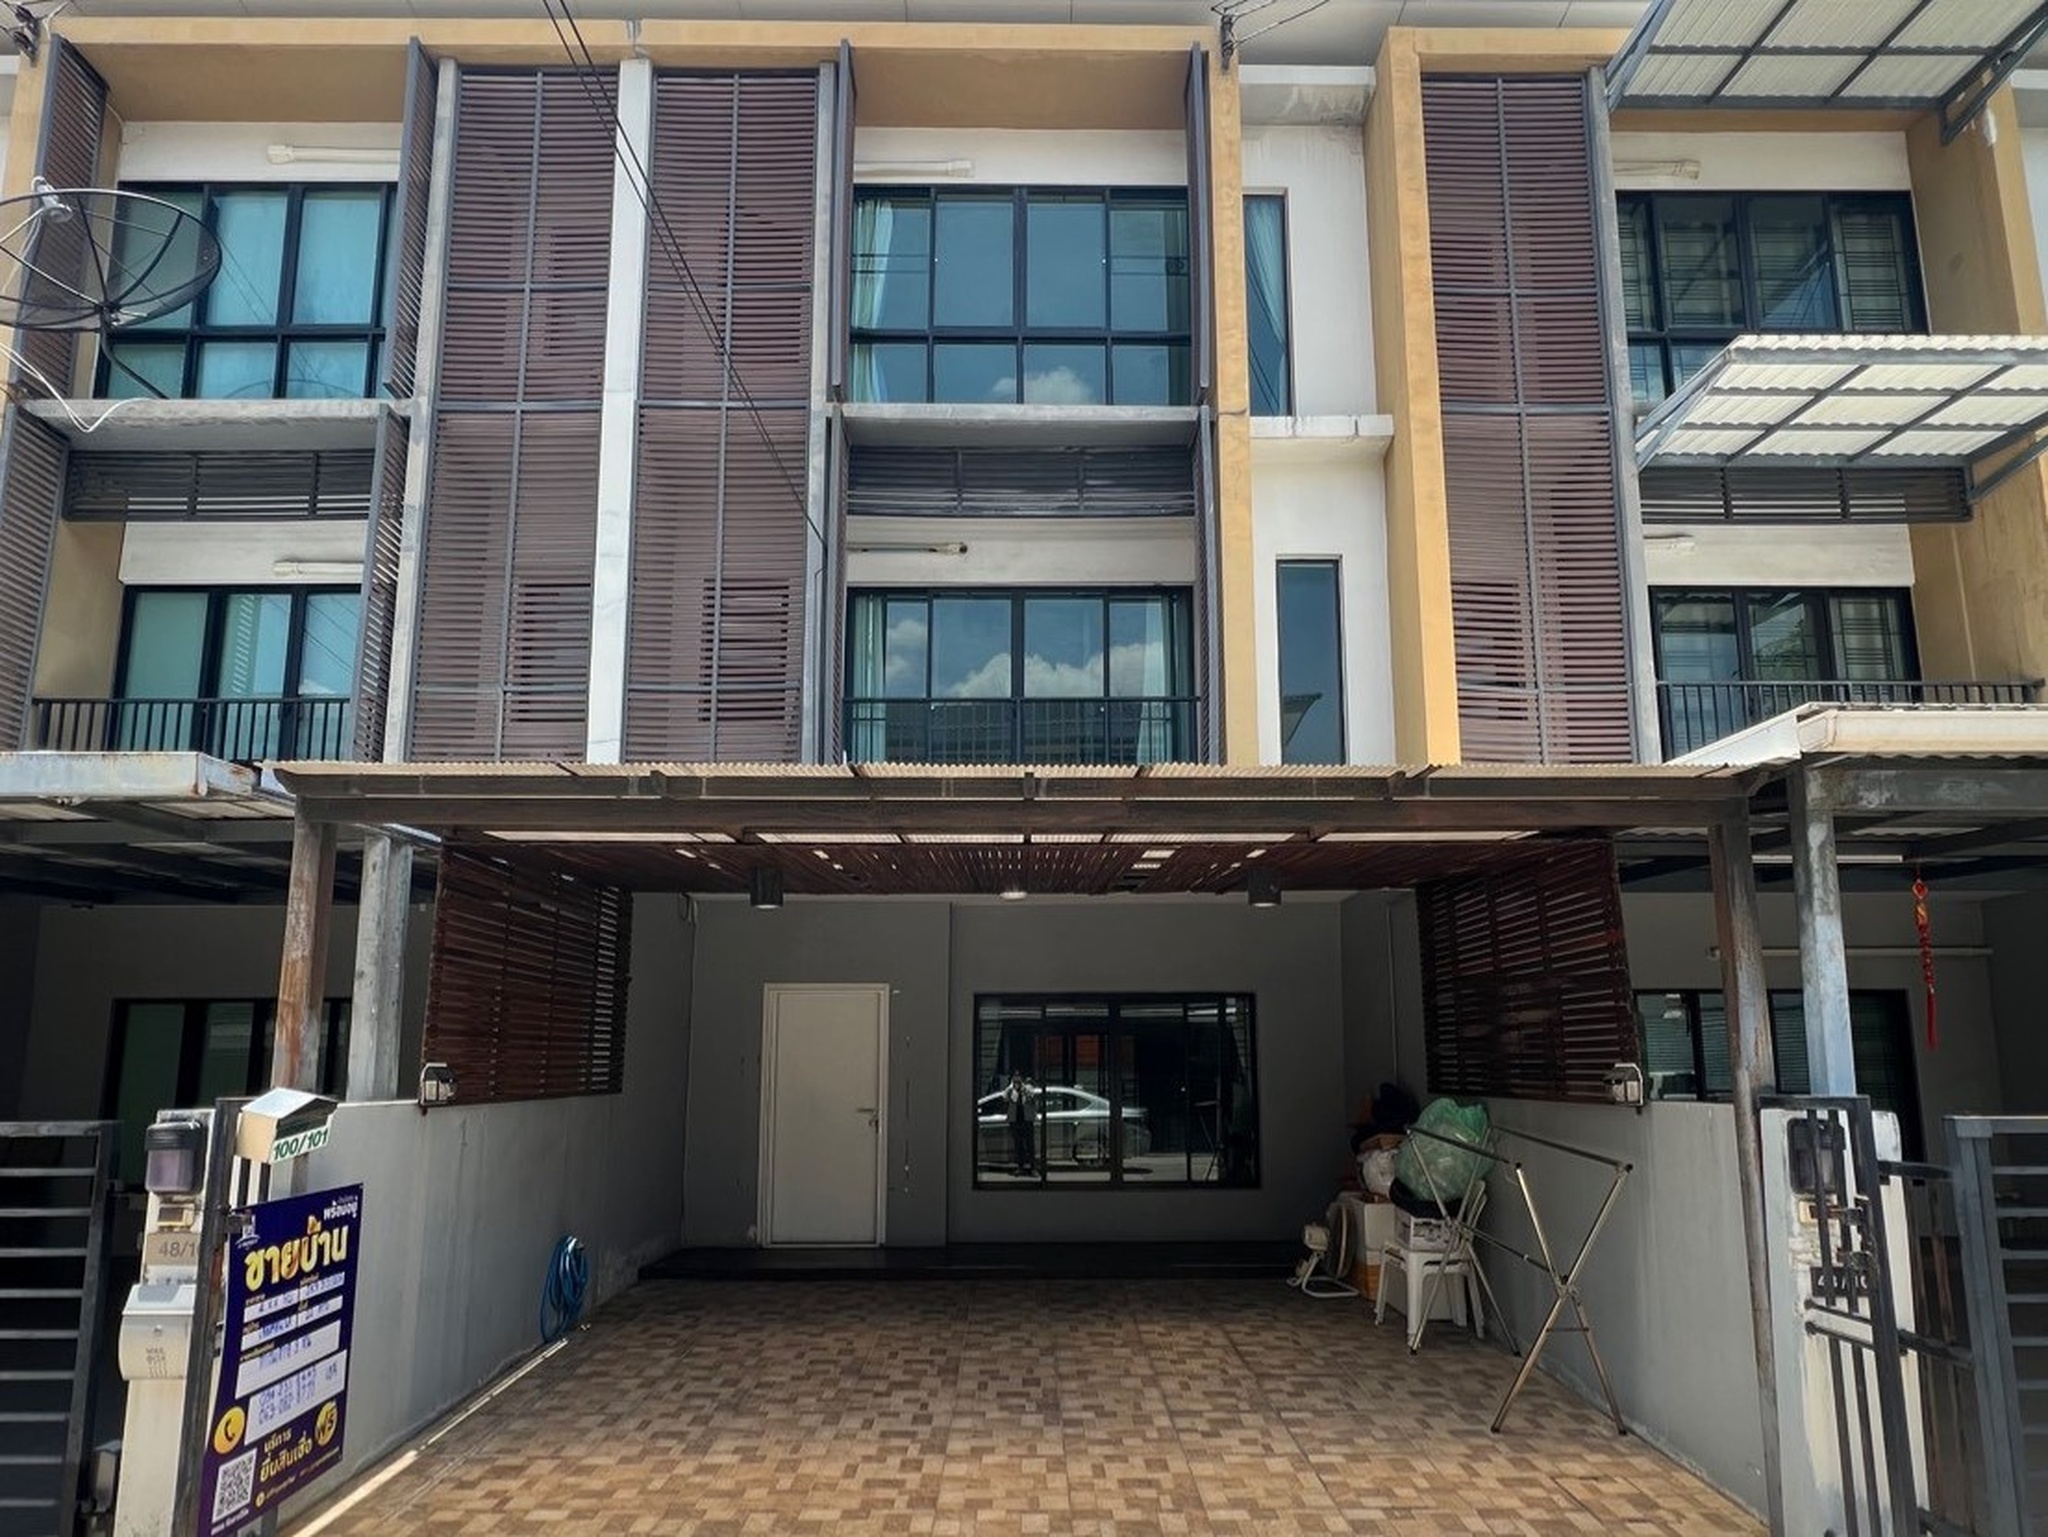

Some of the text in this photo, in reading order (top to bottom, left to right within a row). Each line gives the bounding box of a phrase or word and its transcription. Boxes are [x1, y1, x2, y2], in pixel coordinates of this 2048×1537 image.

[274, 1128, 328, 1160] 100/101
[159, 1241, 199, 1257] 48/1
[244, 1215, 349, 1291] ขายบ้าน
[260, 1430, 313, 1482] ยื่นสินเชื่อ
[264, 1428, 292, 1453] บริการ
